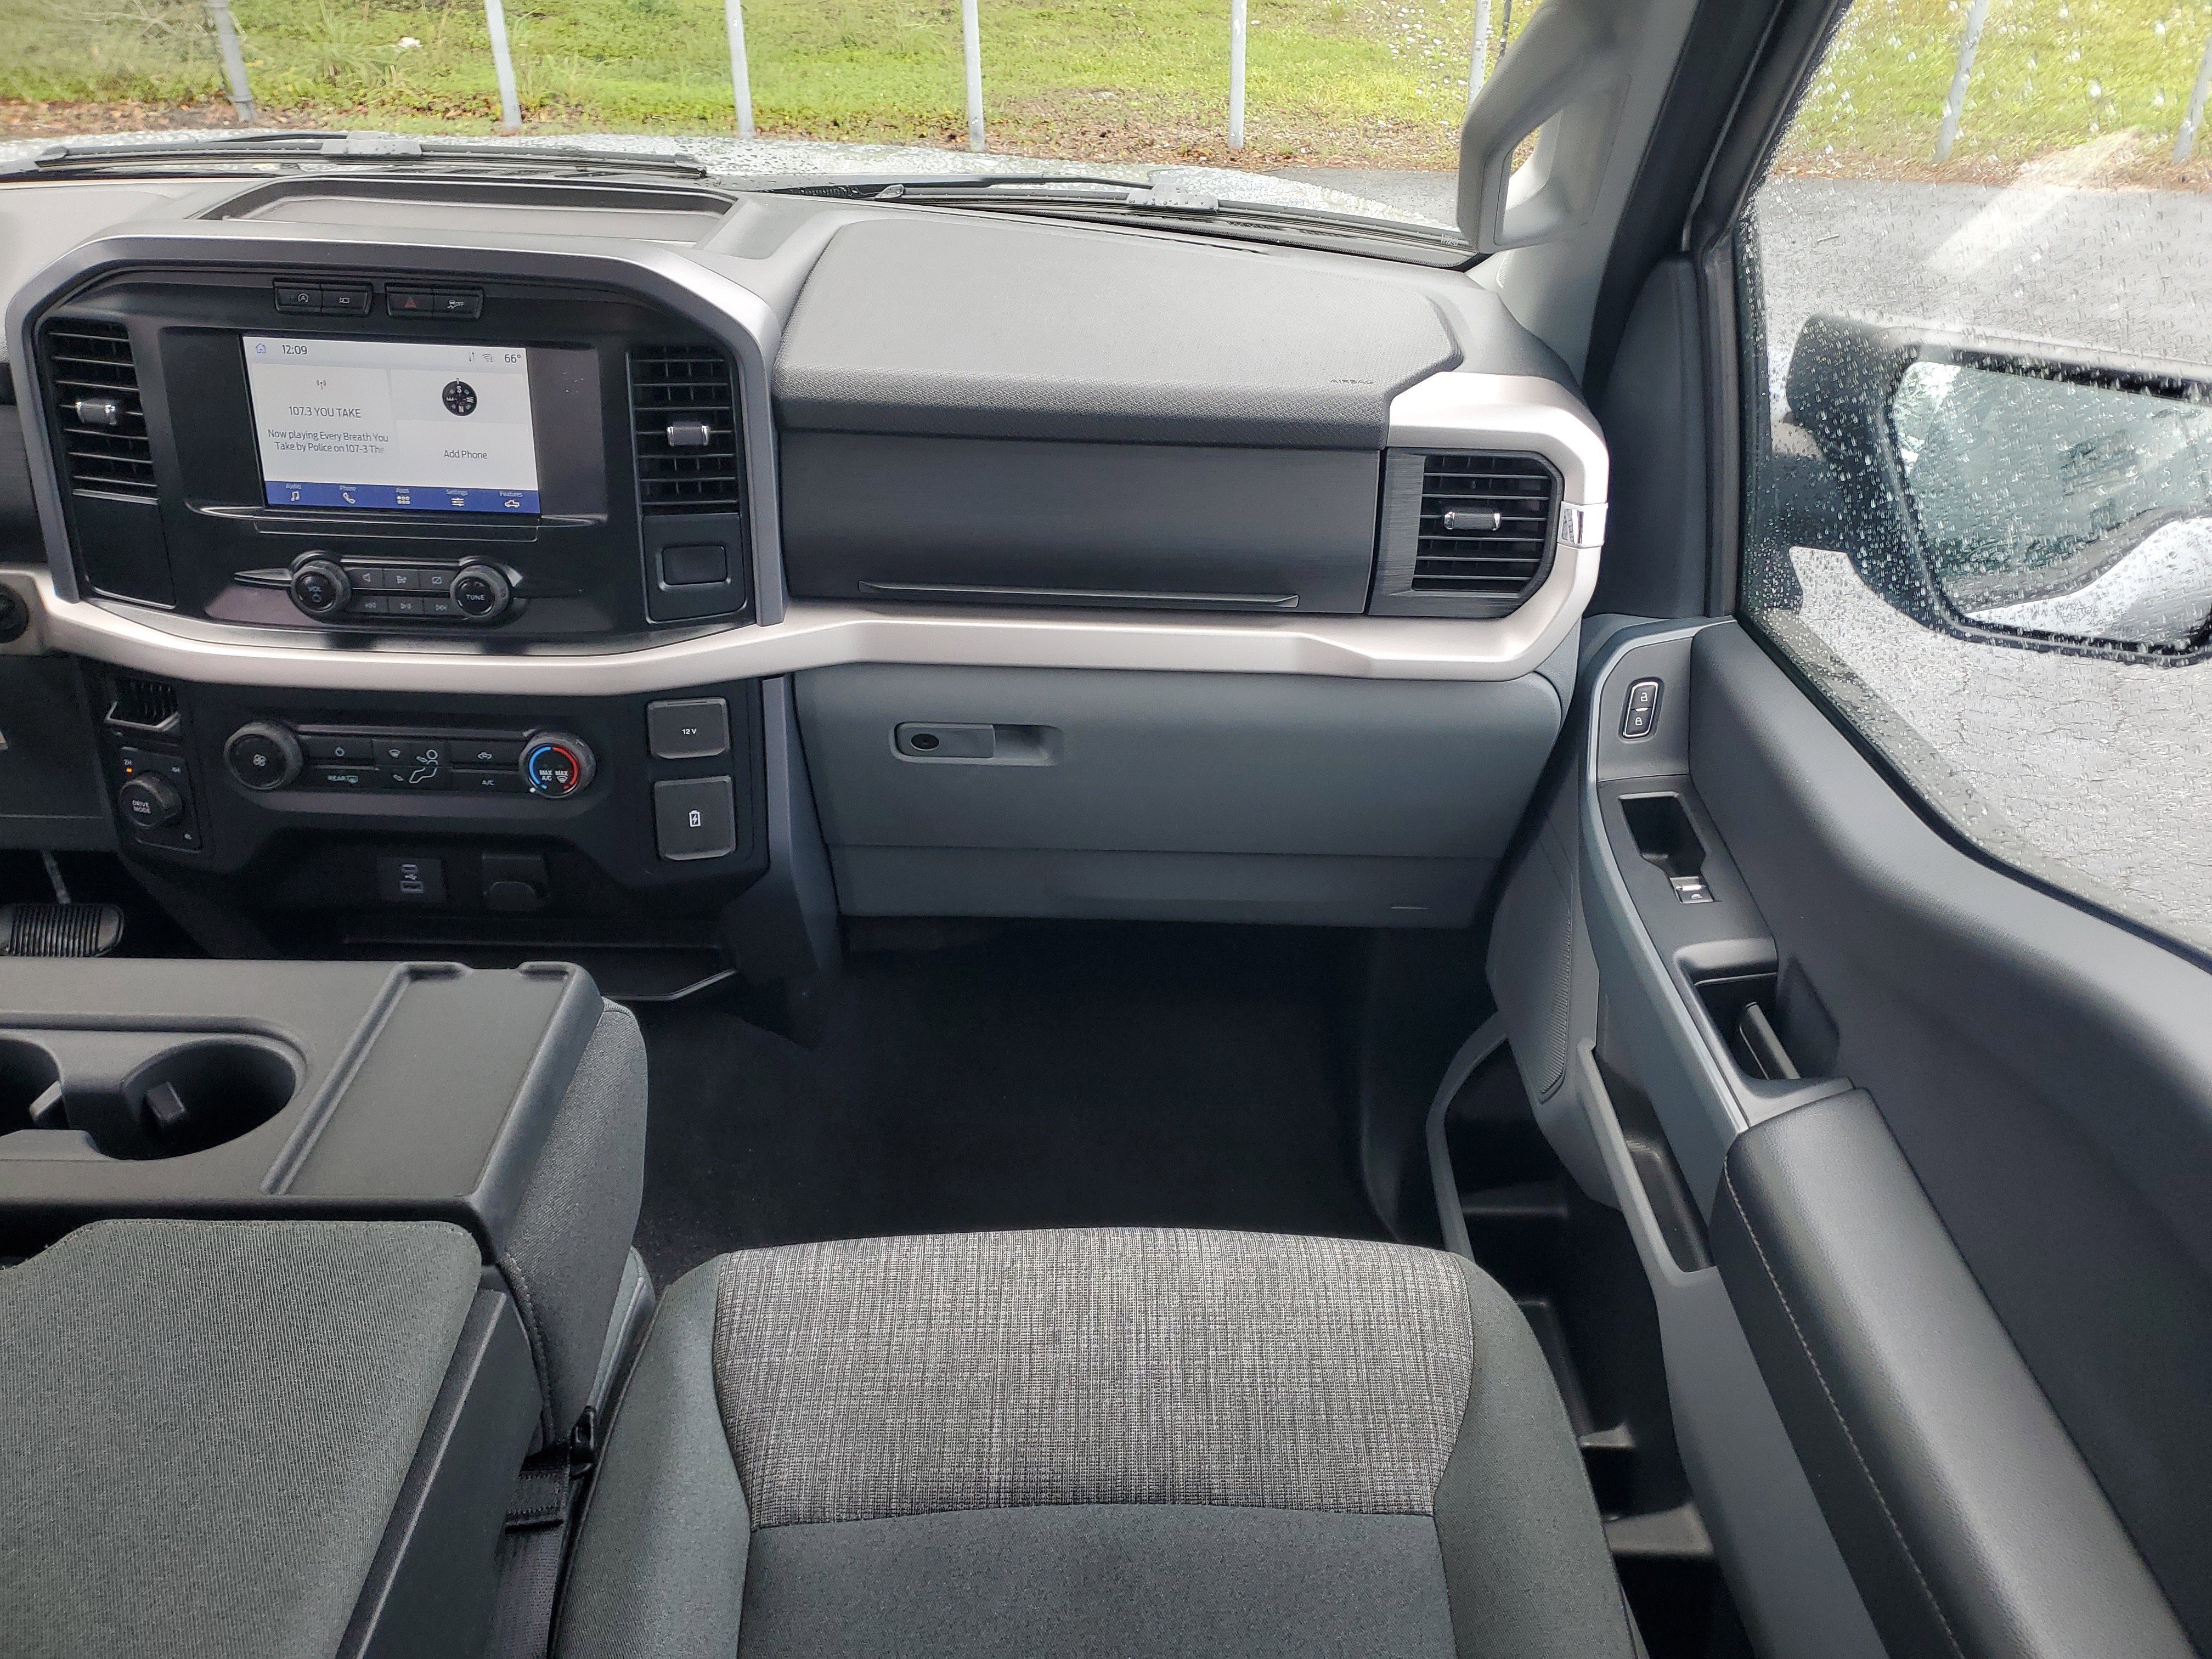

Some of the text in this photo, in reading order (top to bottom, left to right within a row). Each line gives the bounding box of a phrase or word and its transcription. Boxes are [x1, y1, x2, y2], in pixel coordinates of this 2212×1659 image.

[281, 345, 308, 355] 12:09
[504, 354, 521, 364] 66°
[289, 406, 362, 419] 107.3 YOU TAKE
[267, 429, 388, 443] Now playing Every Breath You
[275, 441, 295, 450] Take
[296, 442, 306, 452] by
[308, 443, 332, 452] Police
[346, 444, 368, 453] 107-3
[444, 449, 488, 460] Add Phone
